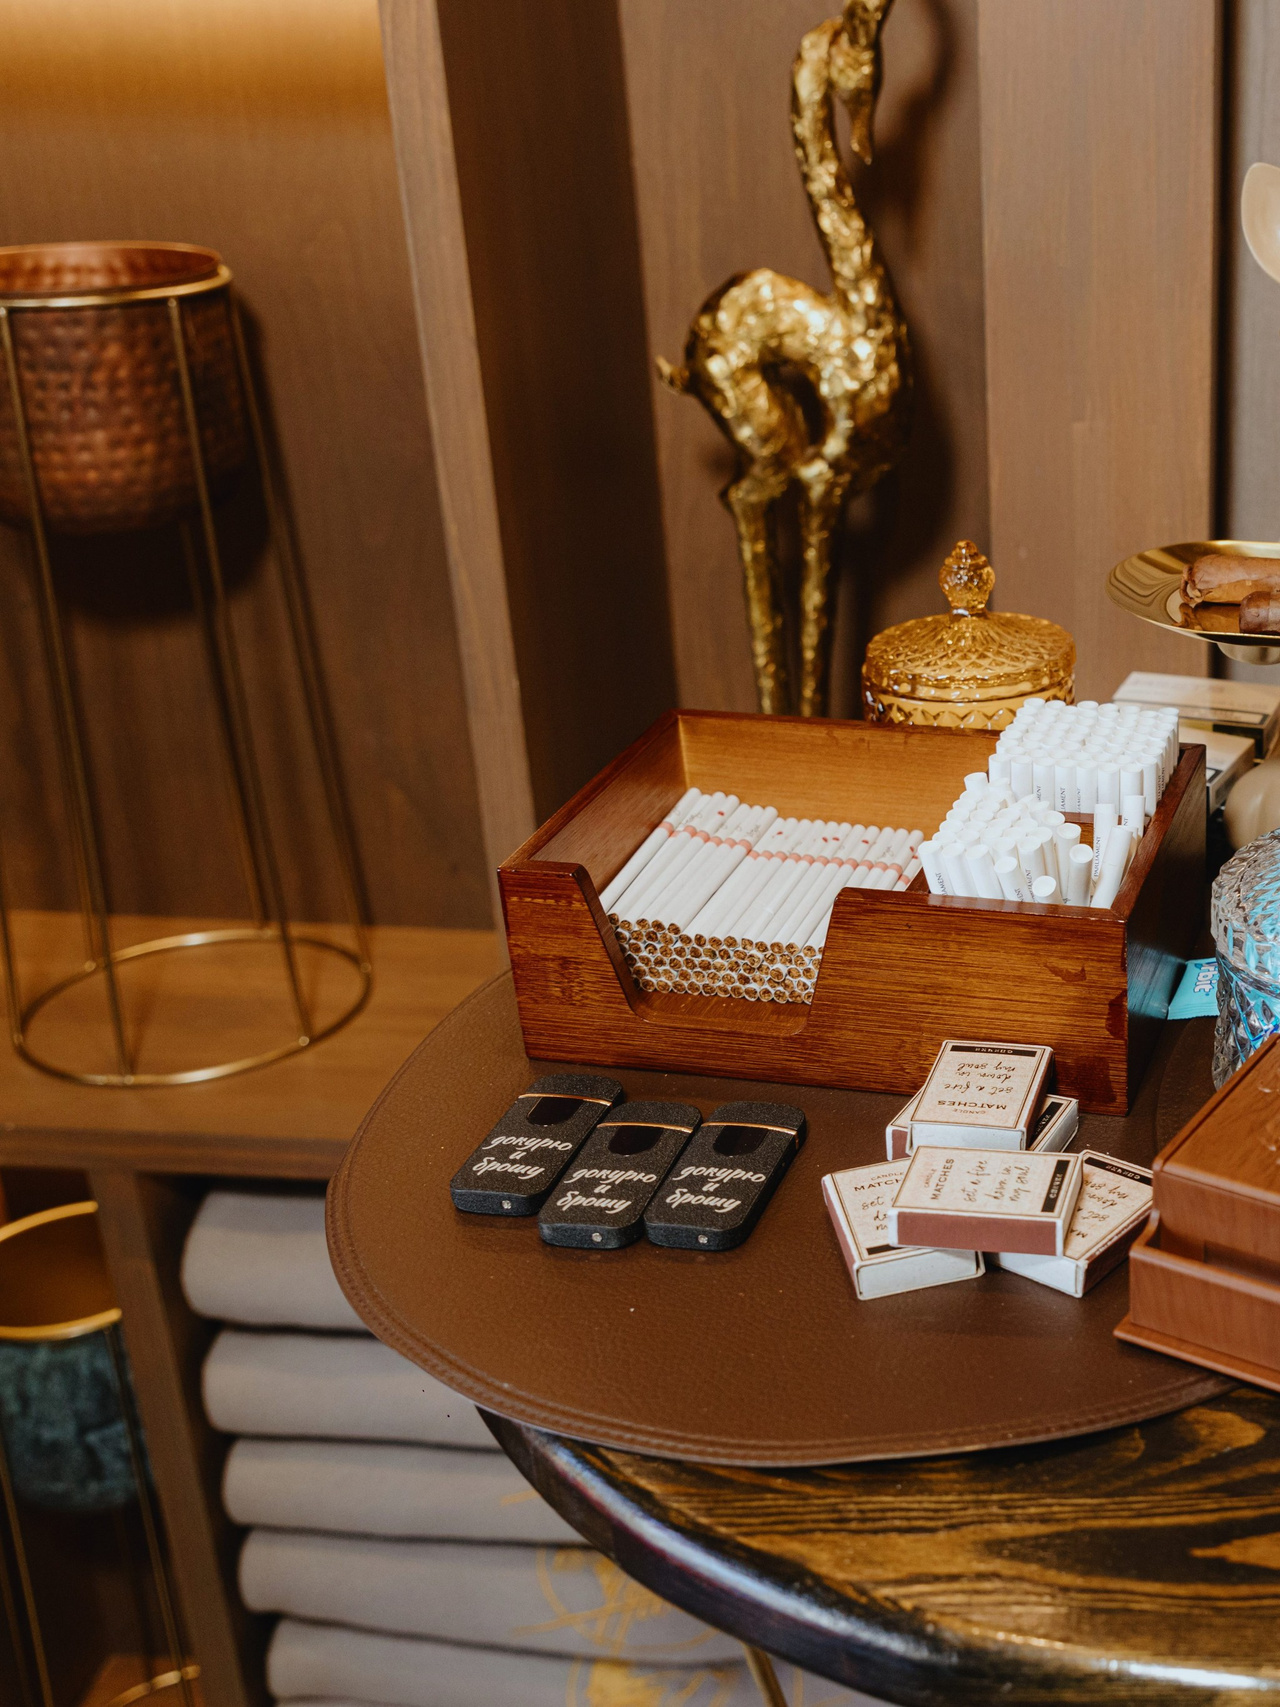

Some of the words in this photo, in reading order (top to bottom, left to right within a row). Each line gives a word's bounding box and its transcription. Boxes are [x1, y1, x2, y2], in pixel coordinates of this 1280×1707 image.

[1093, 836, 1101, 877] PARLIAMENT
[957, 1062, 989, 1072] soul
[993, 1061, 1016, 1073] my
[977, 1072, 1012, 1084] down
[944, 1081, 971, 1094] fire
[989, 1086, 1013, 1096] set
[938, 1100, 1007, 1110] MATCHES
[482, 1136, 573, 1152] докурю
[509, 1151, 527, 1160] и
[472, 1157, 545, 1180] брошу
[672, 1166, 766, 1183] докурю
[966, 1159, 990, 1176] fire
[564, 1168, 657, 1185] докурю
[871, 1172, 905, 1181] CANDLE
[924, 1168, 937, 1188] CANDLE
[930, 1158, 955, 1200] MATCHES
[1009, 1165, 1031, 1186] soul
[593, 1184, 612, 1194] и
[702, 1182, 720, 1192] и
[854, 1178, 902, 1192] MATCH
[984, 1178, 1008, 1201] down
[997, 1165, 1012, 1176] in
[1084, 1180, 1106, 1190] sou
[960, 1187, 977, 1203] set
[1009, 1188, 1031, 1202] my
[1108, 1185, 1129, 1199] my
[556, 1191, 632, 1214] брошу
[666, 1188, 741, 1213] брошу
[861, 1196, 885, 1211] set
[1086, 1192, 1117, 1209] down
[1081, 1211, 1109, 1221] set
